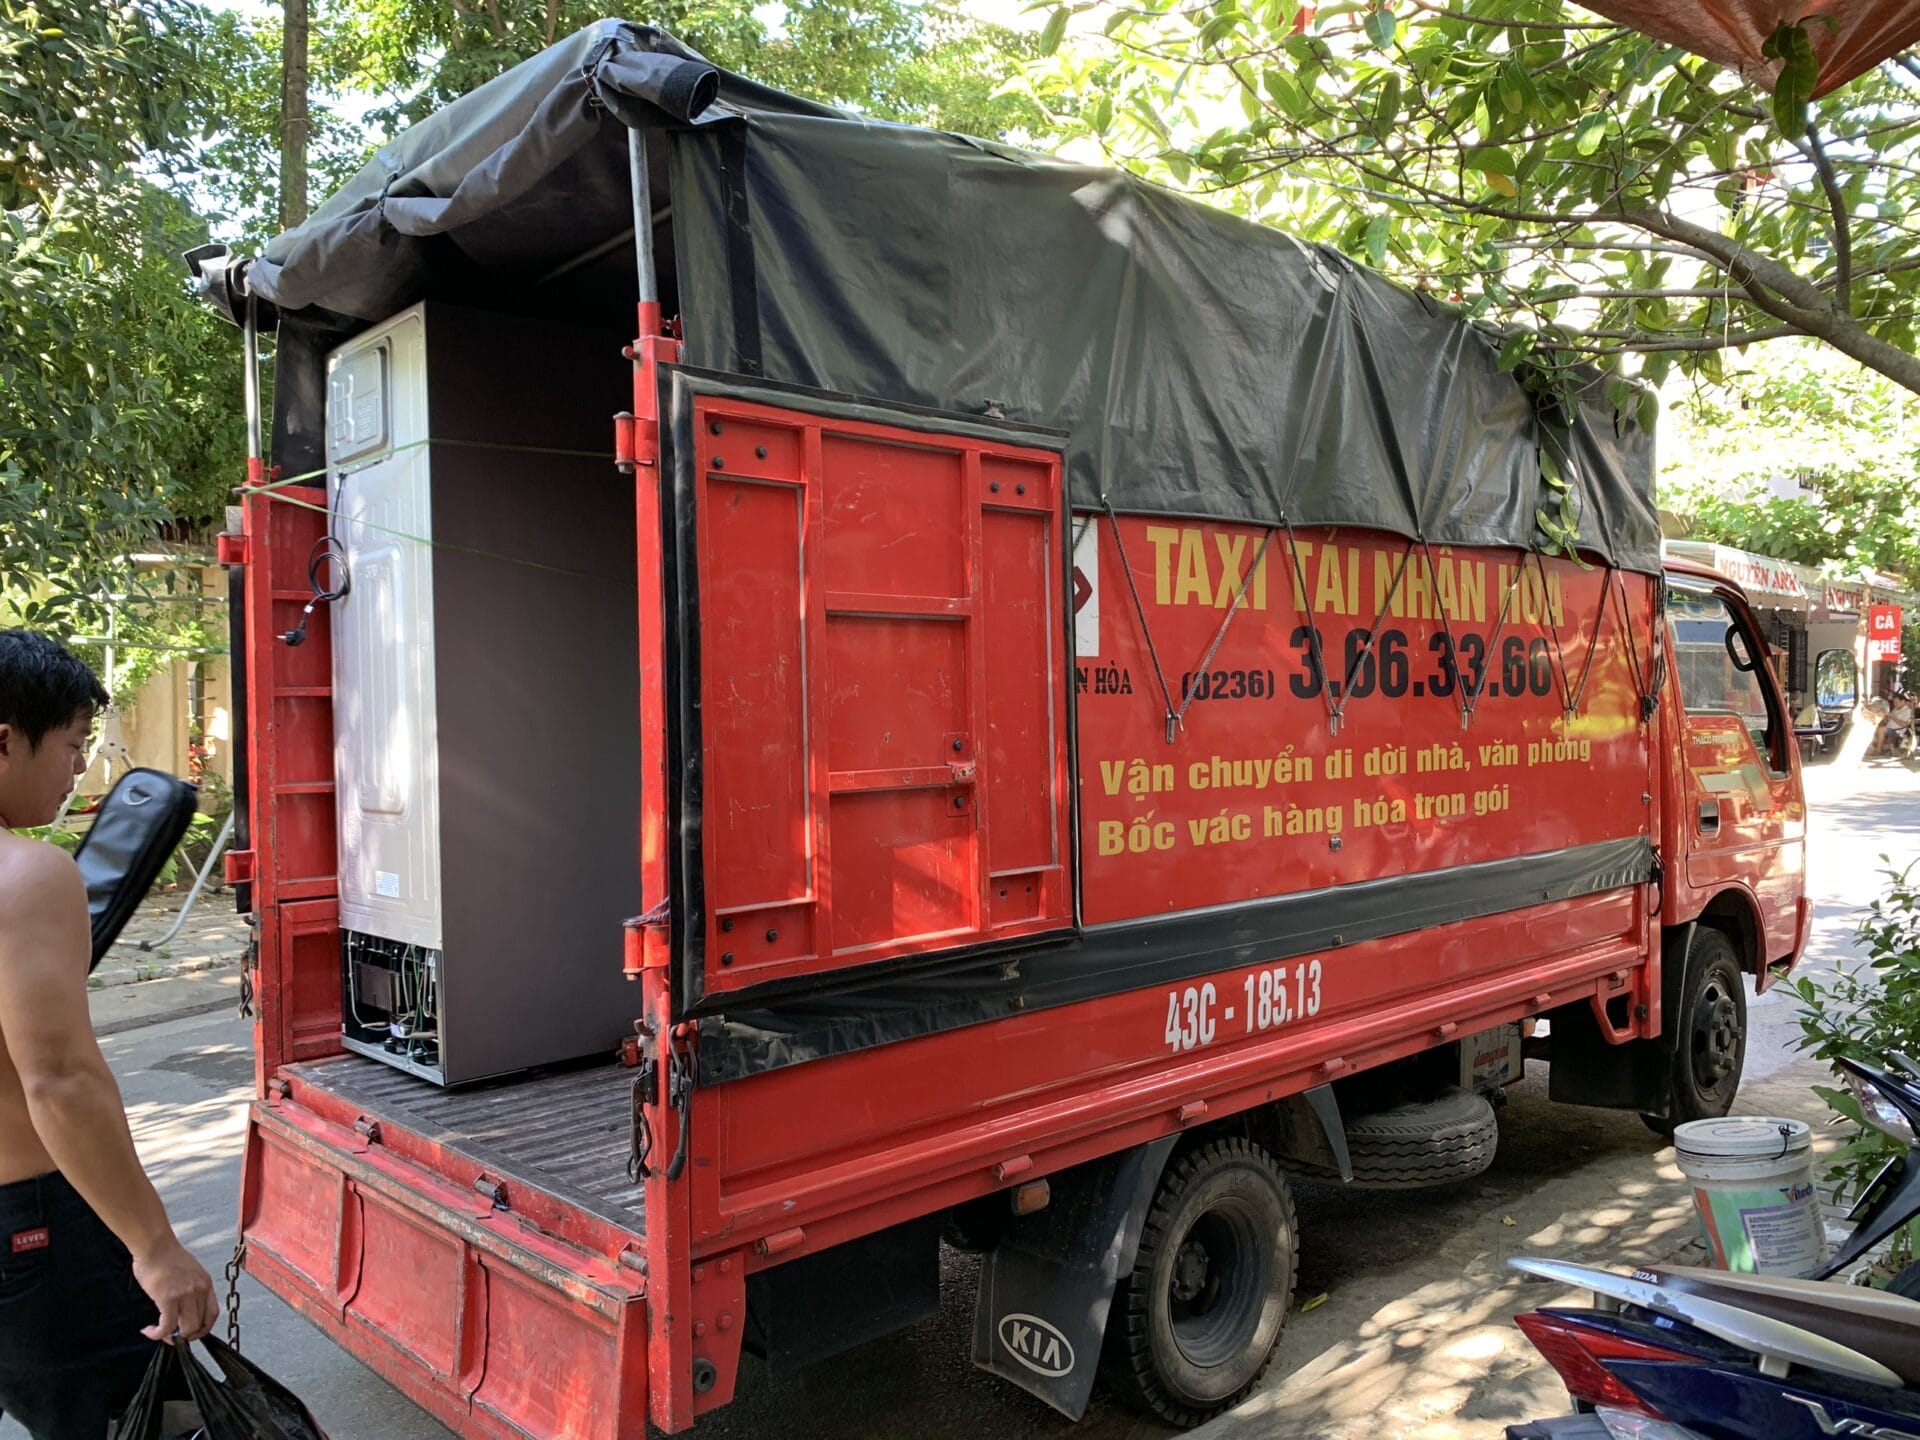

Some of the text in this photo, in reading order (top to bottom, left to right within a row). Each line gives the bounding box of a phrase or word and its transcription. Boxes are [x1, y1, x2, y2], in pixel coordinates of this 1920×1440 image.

[1146, 525, 1267, 610] TAXI
[1374, 546, 1487, 623] NHÂN
[1094, 660, 1133, 695] HÒA
[1181, 669, 1275, 701] (0236)
[1099, 737, 1592, 802] Vận chuyển di dời nhà, văn phòng
[1098, 784, 1510, 857] Bốc vác hàng hóa trọn gói
[1164, 982, 1217, 1053] 43C
[1243, 959, 1323, 1034] 185.13
[1632, 1270, 1659, 1284] NDA
[1011, 1320, 1062, 1371] KIA
